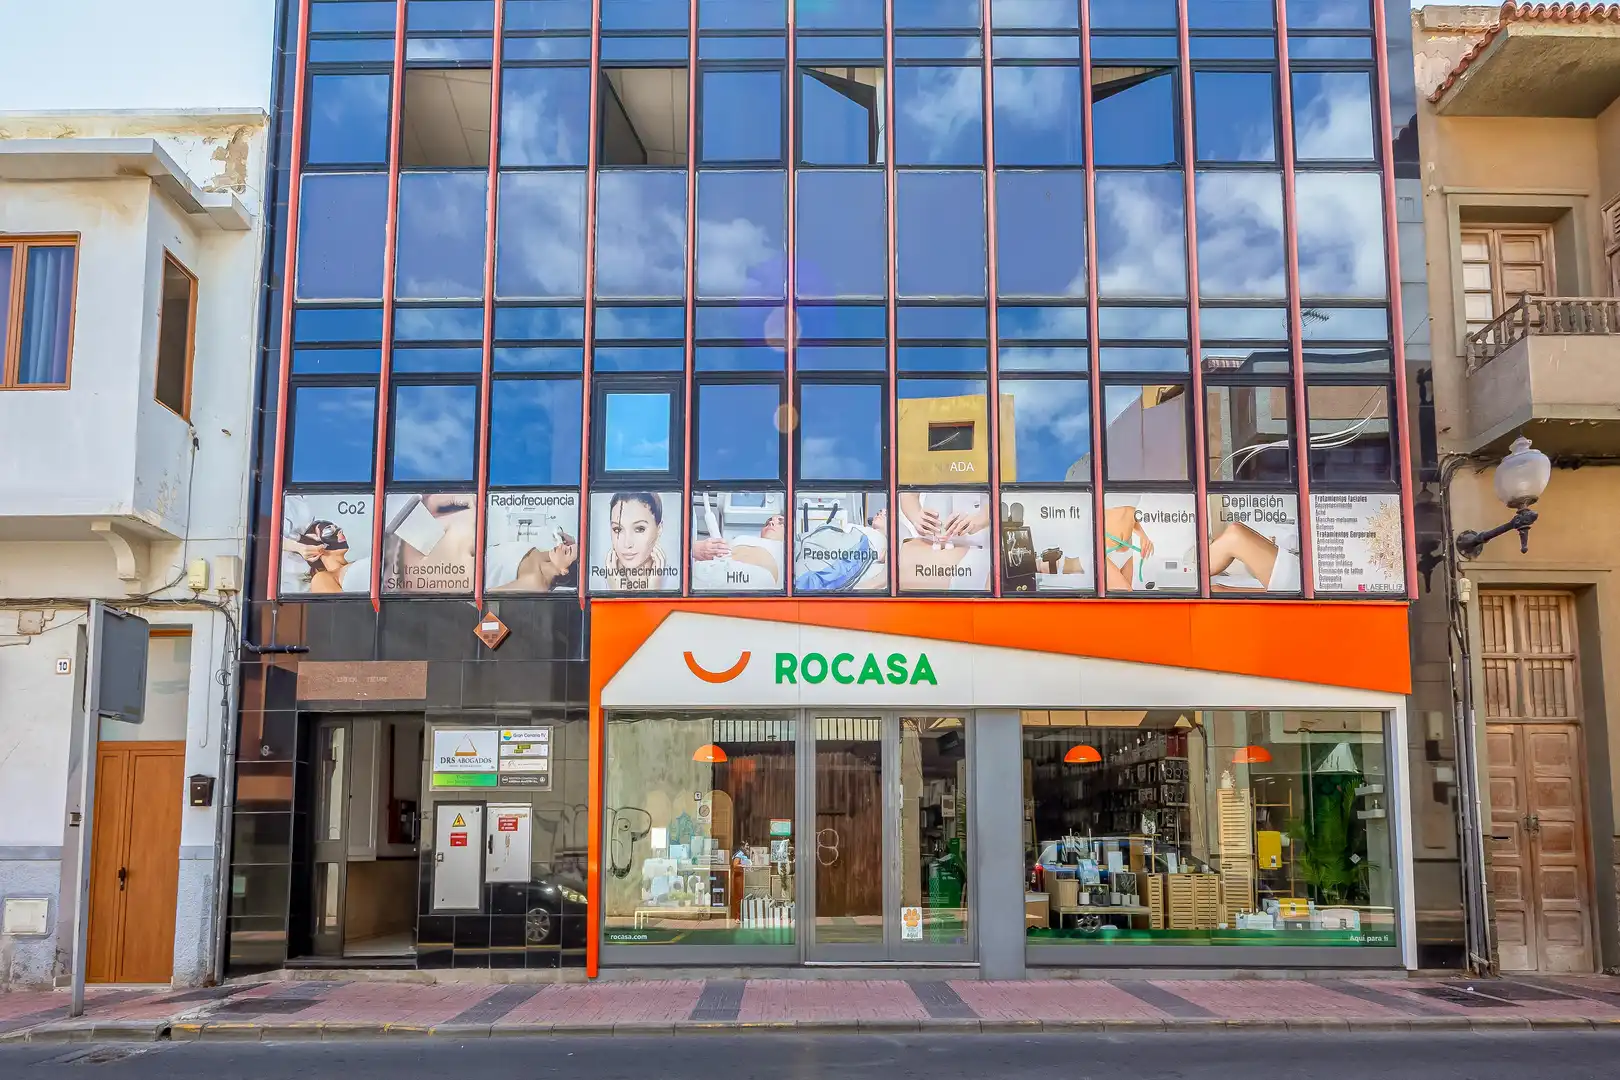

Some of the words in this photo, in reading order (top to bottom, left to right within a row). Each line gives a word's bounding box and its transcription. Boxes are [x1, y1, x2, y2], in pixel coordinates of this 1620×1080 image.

[949, 461, 975, 472] ADA
[491, 494, 575, 507] Radiofrecuencia
[1222, 494, 1284, 511] Depilación
[1314, 495, 1347, 503] Tratamientos
[337, 501, 365, 515] Co2
[1040, 506, 1066, 519] Slim
[1069, 506, 1080, 519] fit
[1134, 509, 1195, 523] Cavitación
[1219, 510, 1251, 523] Laser
[1254, 509, 1287, 523] Diodo
[803, 547, 879, 562] Presoterapia
[392, 562, 466, 575] Utrasonidos
[591, 565, 678, 579] Rejuvenecimiento
[915, 564, 972, 578] Rollaction
[387, 577, 413, 589] Skin
[416, 577, 470, 589] Diamond
[620, 578, 649, 590] Facial
[726, 571, 750, 584] Hifu
[59, 661, 68, 671] 10
[775, 652, 938, 685] ROCASA
[440, 756, 456, 764] DRS
[1366, 935, 1382, 943] para
